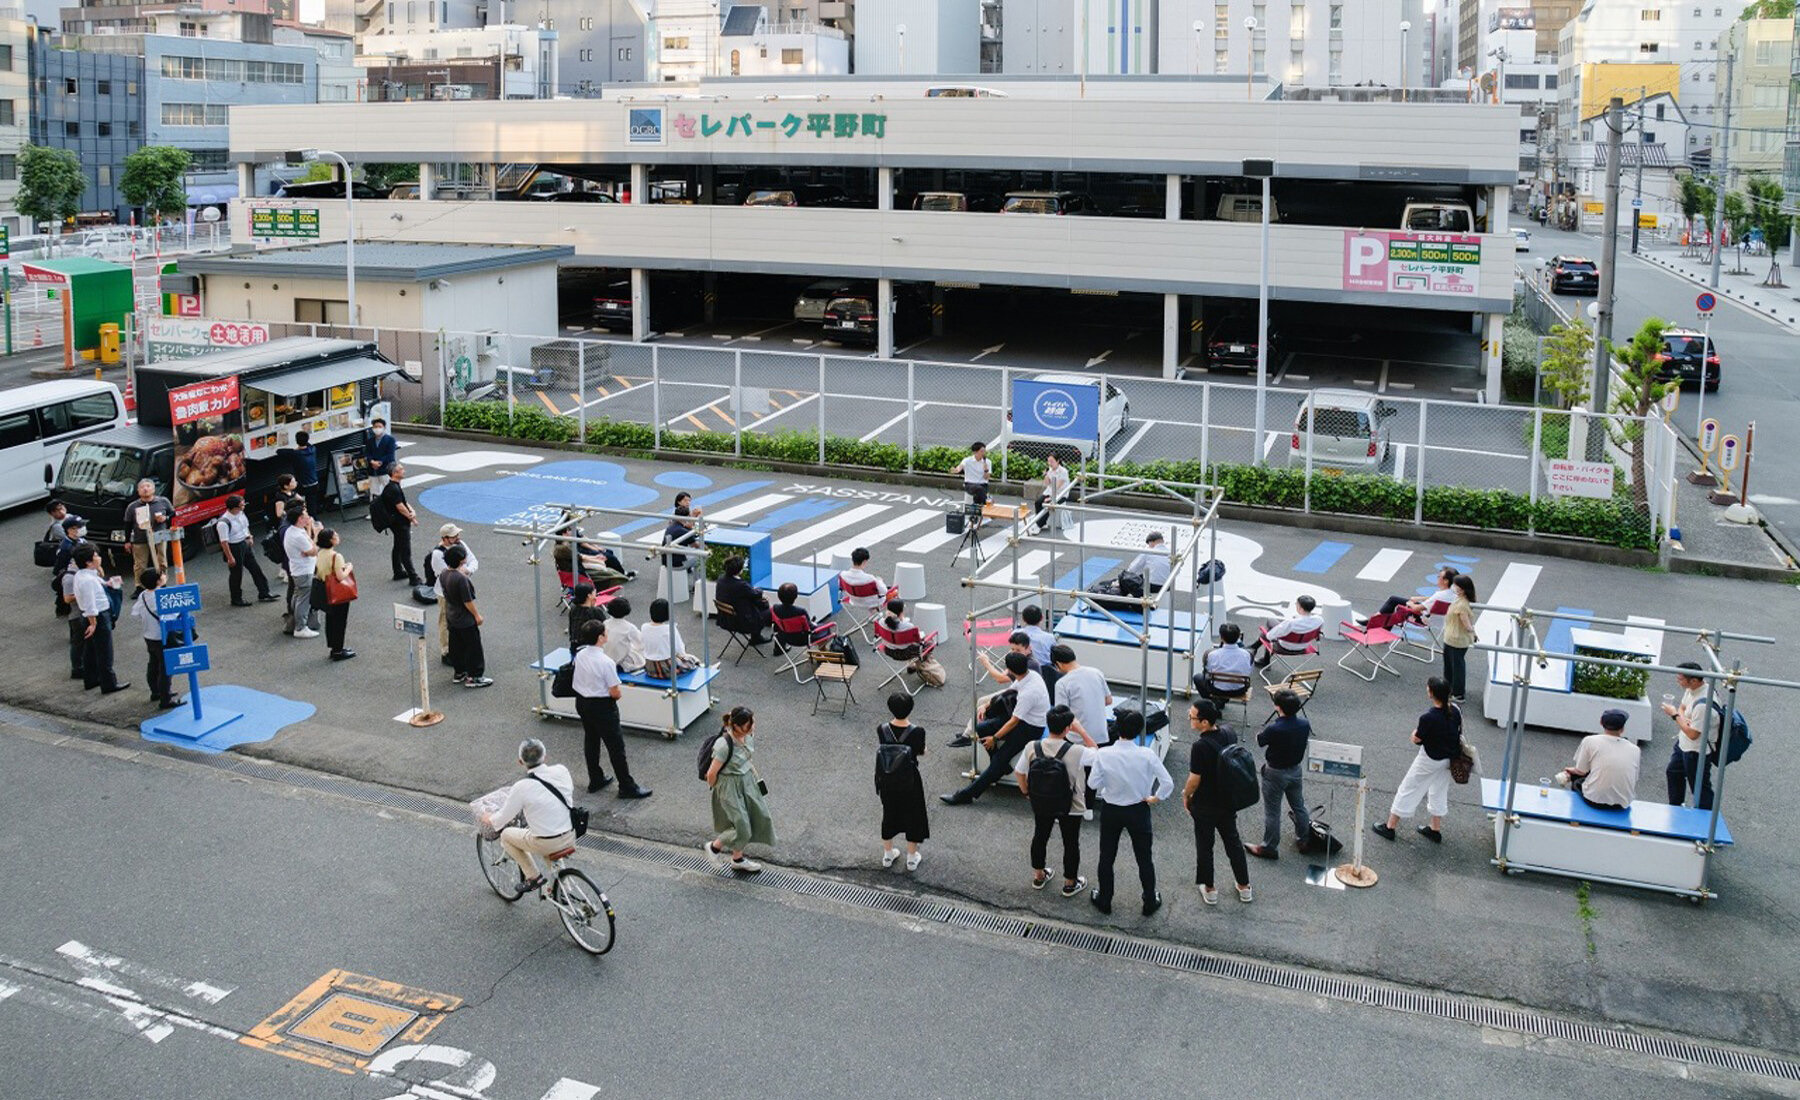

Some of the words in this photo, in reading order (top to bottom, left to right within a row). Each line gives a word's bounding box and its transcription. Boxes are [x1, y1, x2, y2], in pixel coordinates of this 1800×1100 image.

[674, 113, 887, 138] セレパーク平野町
[1350, 237, 1384, 276] P
[1391, 249, 1417, 258] 2,300円
[1421, 250, 1447, 260] 500円
[1452, 252, 1478, 262] 500円
[1401, 263, 1464, 274] セレパーク平野町
[182, 296, 197, 313] P
